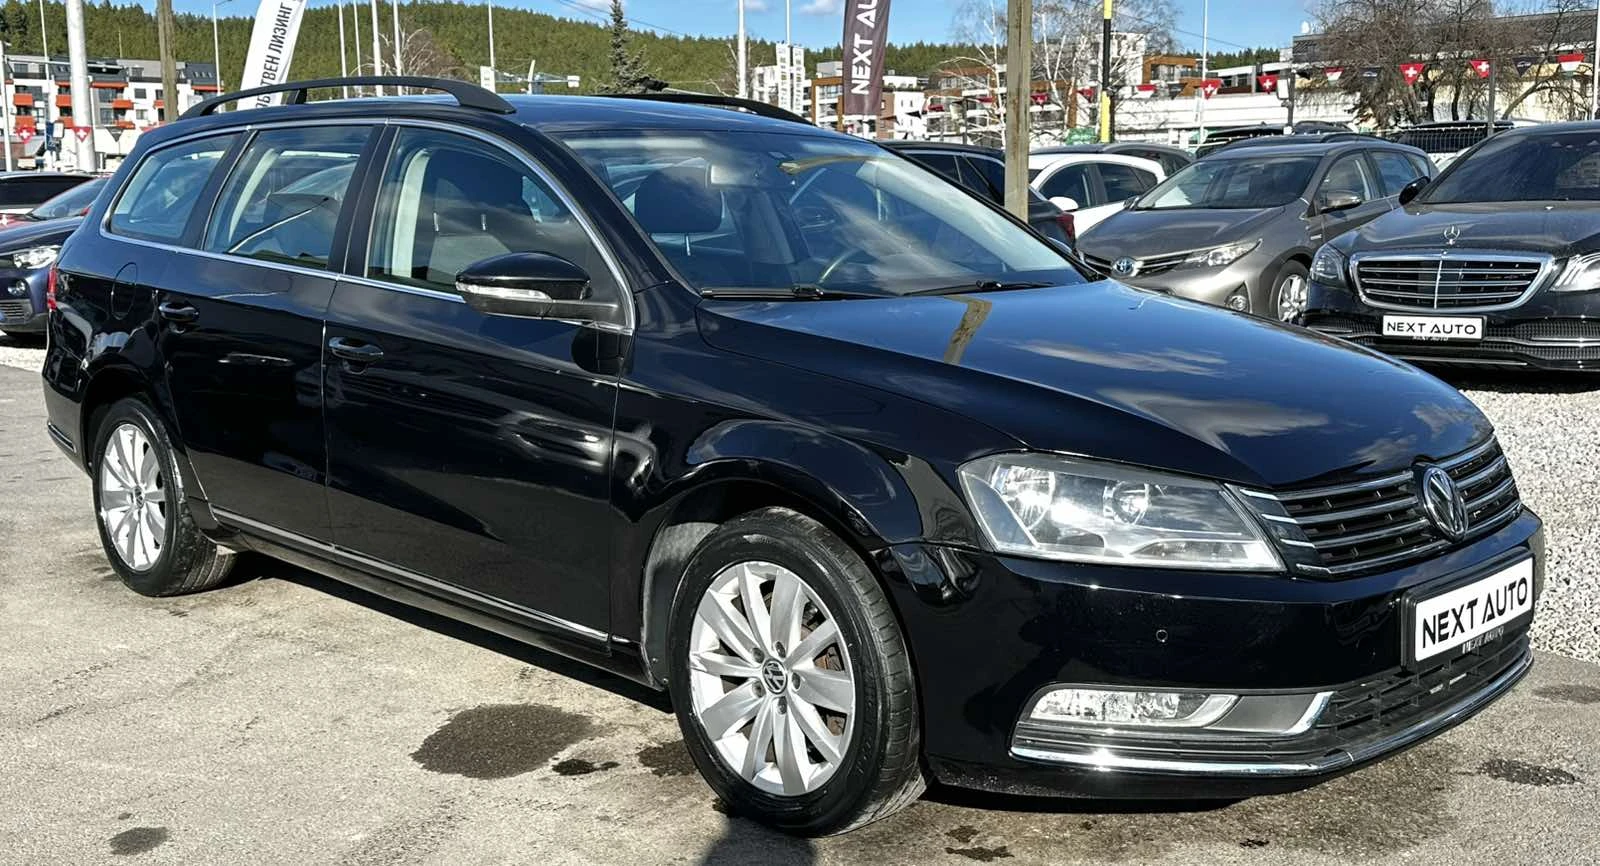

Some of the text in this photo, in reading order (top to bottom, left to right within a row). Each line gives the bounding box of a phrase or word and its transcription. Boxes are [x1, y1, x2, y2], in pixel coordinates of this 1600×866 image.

[268, 2, 293, 55] ЛИЗИНГ
[851, 33, 873, 95] NEXT
[1387, 322, 1477, 335] NEXT AUTO
[1422, 576, 1528, 649] NEXT AUTO
